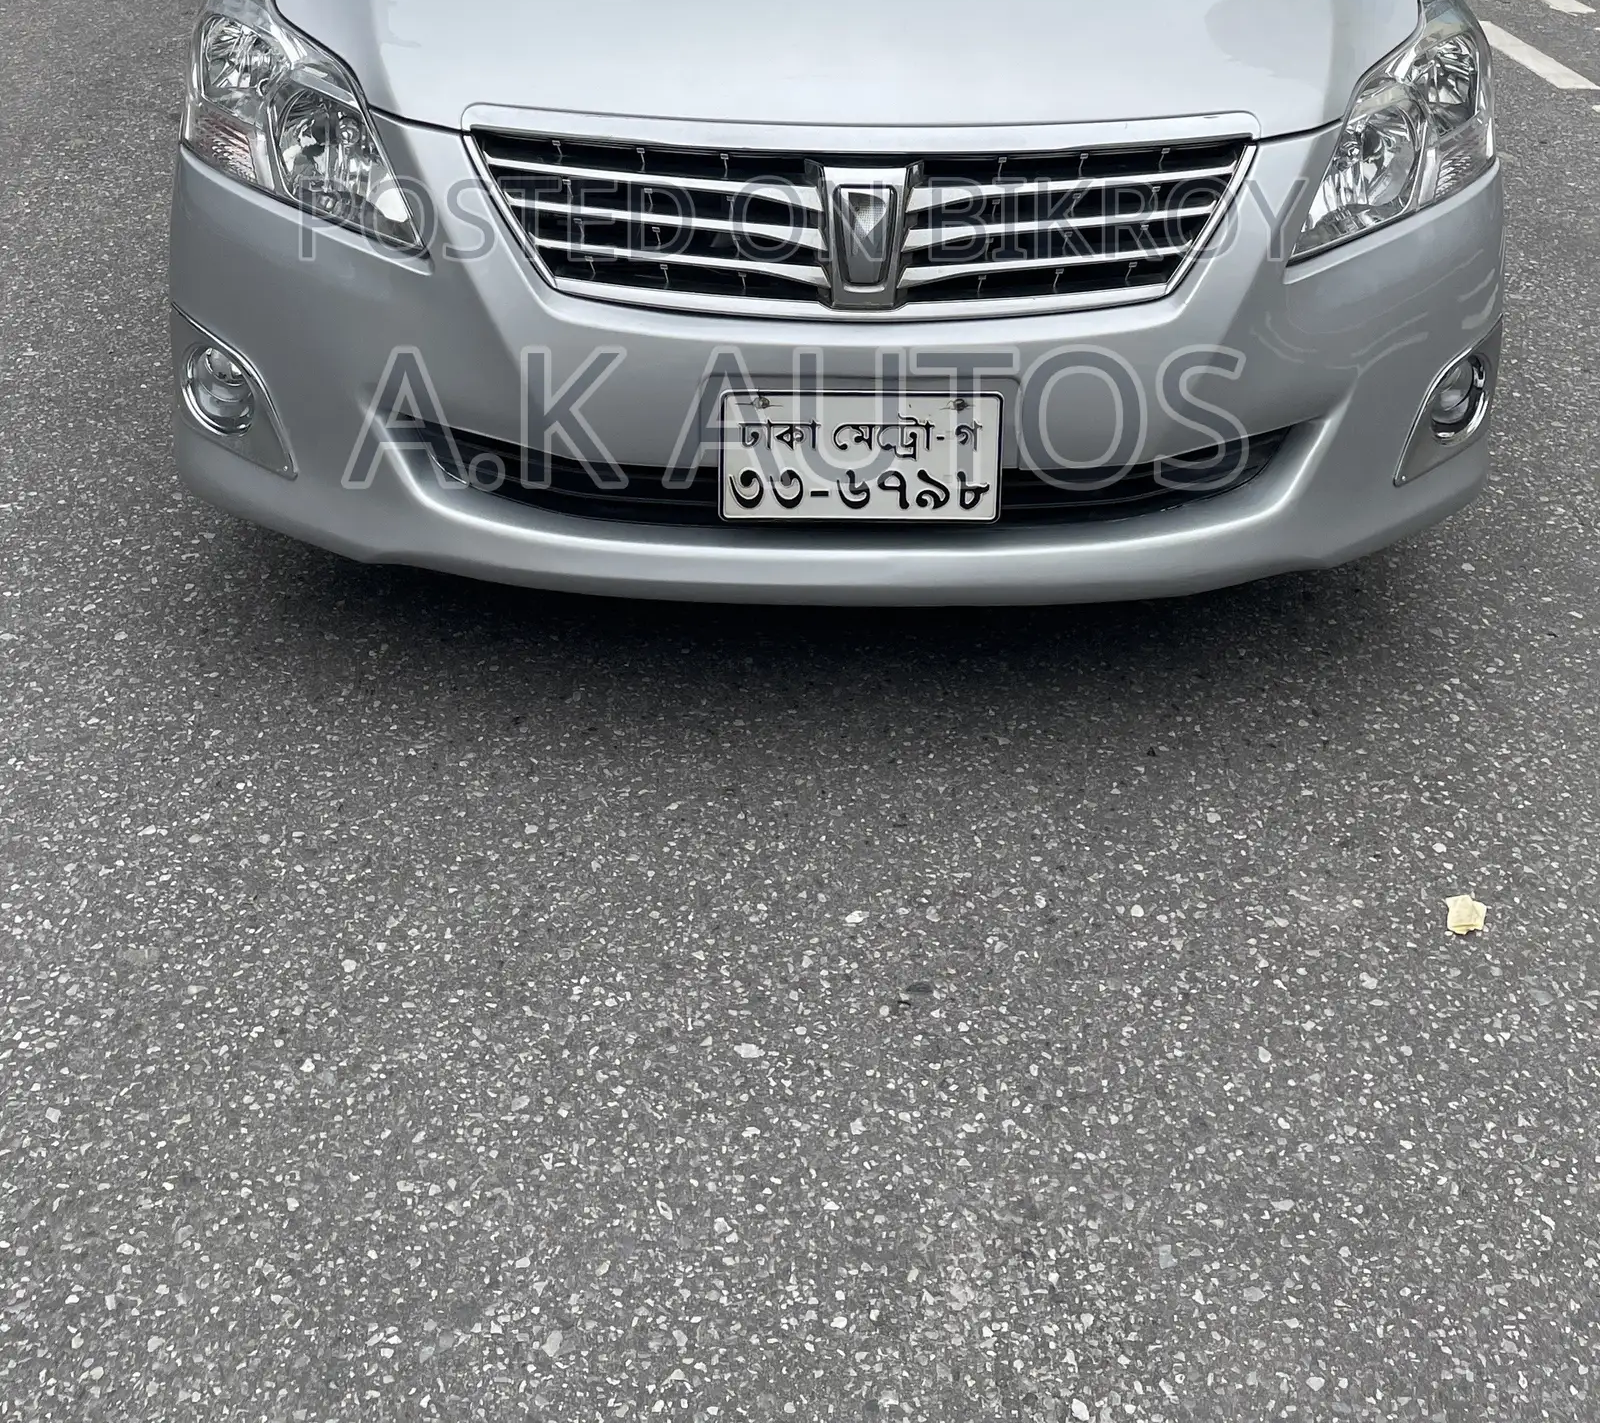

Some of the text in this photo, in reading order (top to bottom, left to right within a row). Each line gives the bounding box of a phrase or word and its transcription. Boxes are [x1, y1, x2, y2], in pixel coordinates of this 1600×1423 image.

[738, 413, 983, 461] ঢাকা মেট্রো-গ
[729, 469, 990, 510] ৩৩-৬৭৯৮
